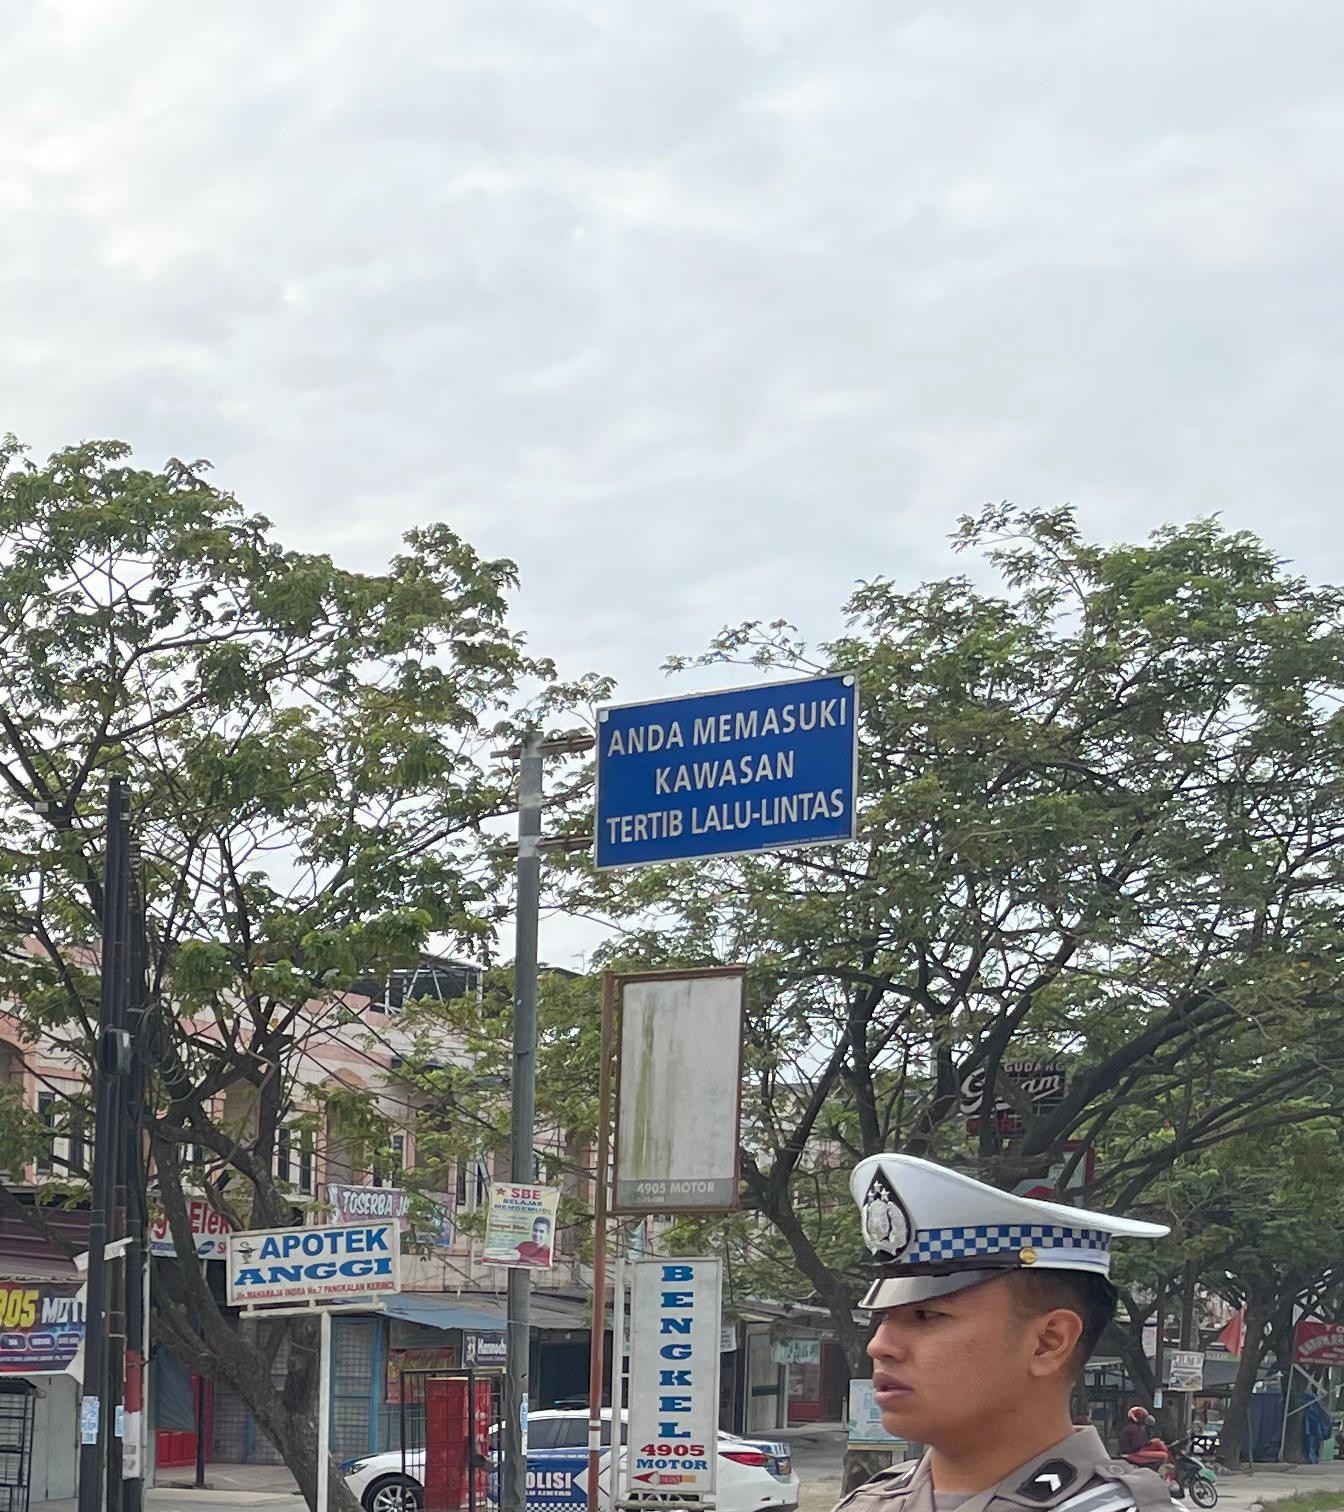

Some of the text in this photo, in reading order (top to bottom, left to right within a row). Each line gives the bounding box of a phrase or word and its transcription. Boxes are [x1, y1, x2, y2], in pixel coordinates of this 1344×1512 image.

[608, 697, 847, 757] ANDA MEMASUKI
[655, 750, 795, 795] KAWASAN
[606, 788, 844, 844] TERTIB LALU-LINTAS
[1004, 1061, 1065, 1073] GUDANG
[511, 1188, 541, 1200] SBE
[636, 1181, 715, 1194] 4905 MOTOR
[342, 1190, 392, 1216] TOSERBA
[259, 1227, 388, 1260] APOTEK
[234, 1257, 392, 1286] ANGGI
[658, 1265, 695, 1438] BENGKEL
[640, 1444, 705, 1457] 4905
[637, 1459, 708, 1470] MOTOR
[525, 1472, 572, 1489] OLISI
